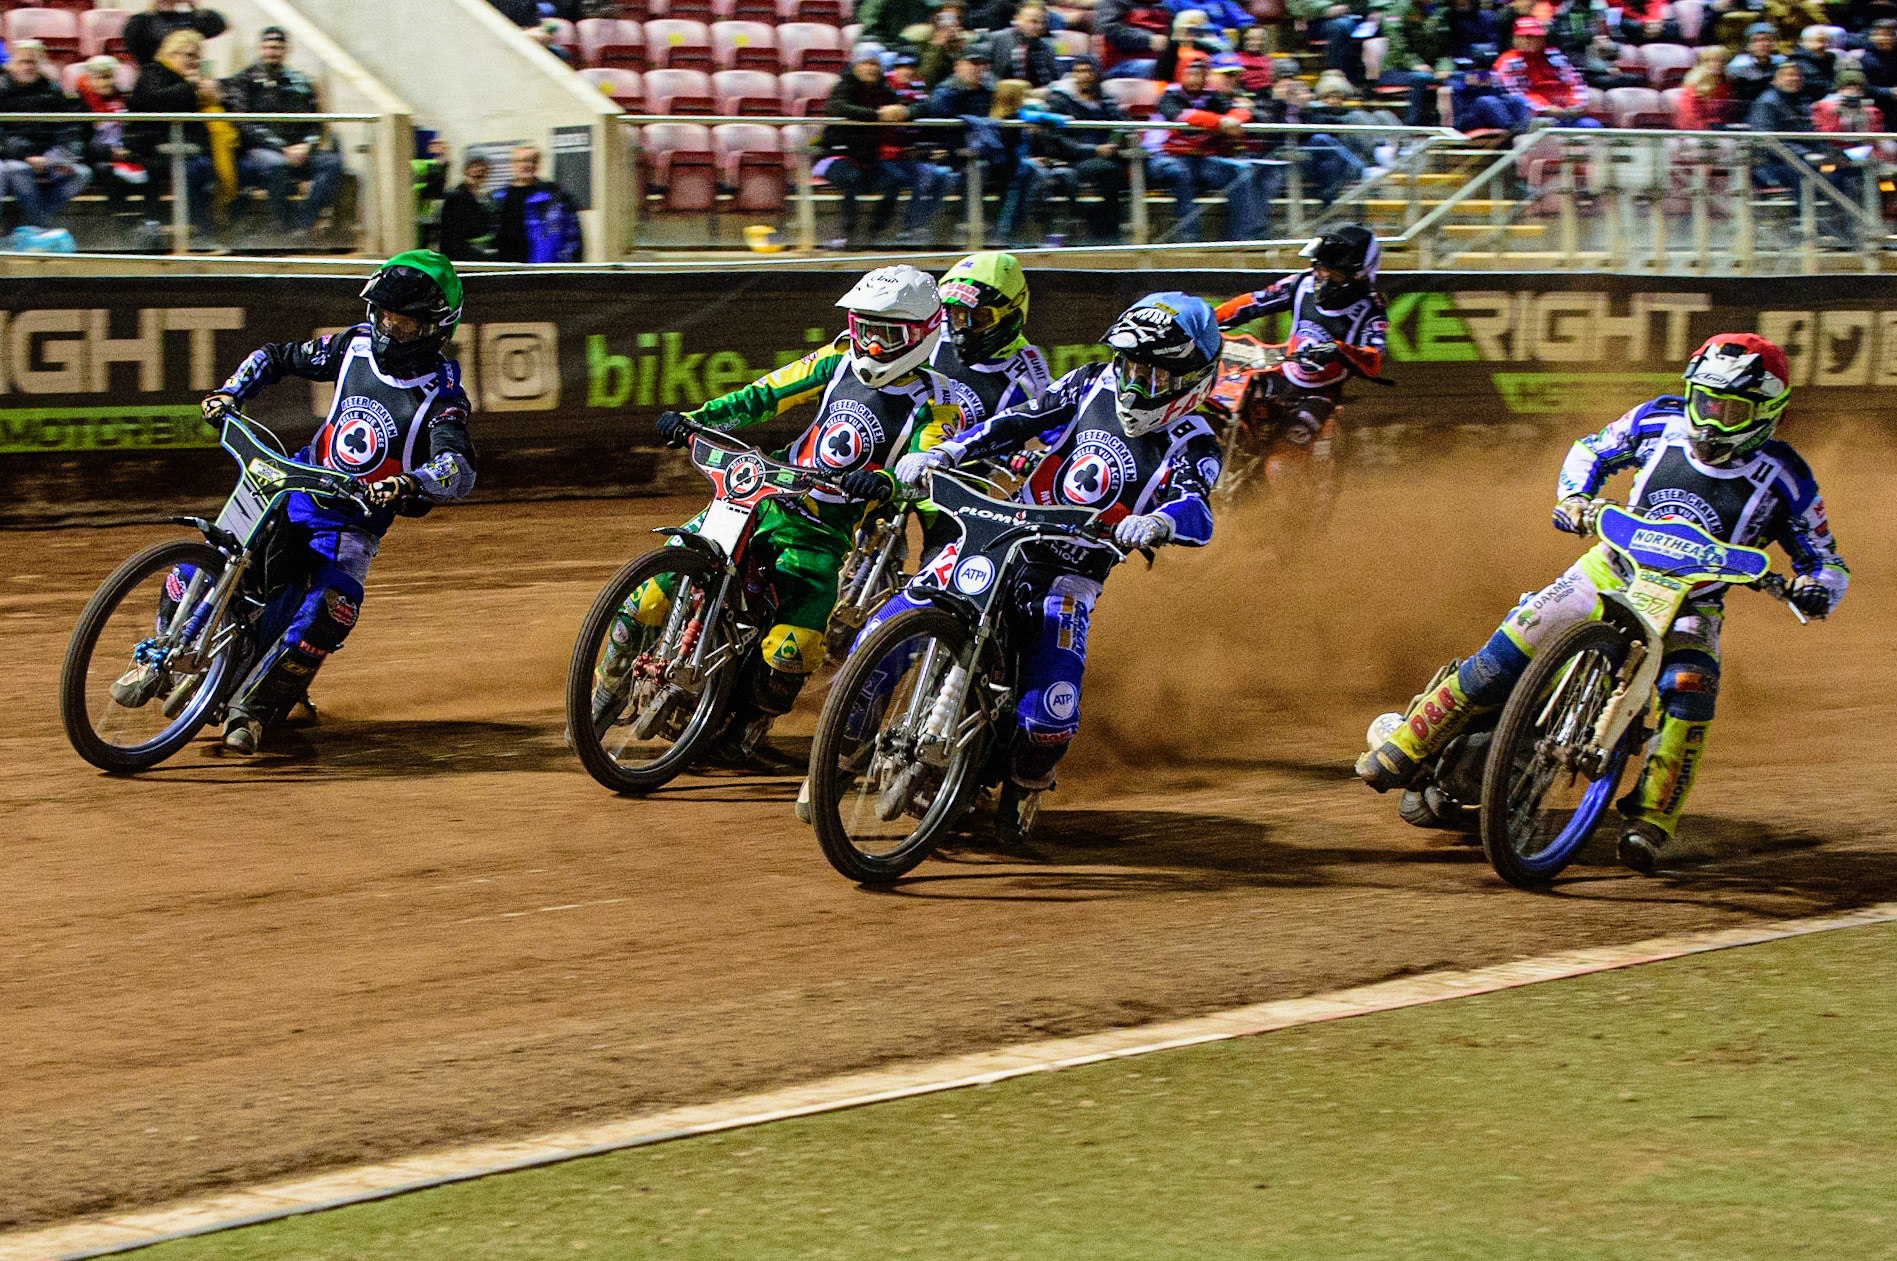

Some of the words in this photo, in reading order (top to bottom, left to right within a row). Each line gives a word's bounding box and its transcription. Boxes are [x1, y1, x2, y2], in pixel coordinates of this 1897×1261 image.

[340, 396, 370, 411] PETER
[368, 400, 398, 438] CRAVEN
[362, 413, 378, 426] VUE
[374, 427, 385, 448] ACES
[829, 399, 858, 414] PETER
[856, 403, 886, 444] CRAVEN
[848, 415, 863, 431] VUE
[860, 431, 871, 453] ACES
[1072, 446, 1096, 462] BELLE
[1098, 448, 1114, 465] VUE
[1110, 466, 1121, 491] ACES
[1076, 429, 1110, 445] PETER
[1107, 435, 1138, 482] CRAVEN
[1648, 488, 1688, 506] PETER
[1678, 506, 1698, 521] VUE
[961, 568, 987, 583] ATPI
[1631, 592, 1671, 615] 37
[1410, 686, 1455, 740] D&B
